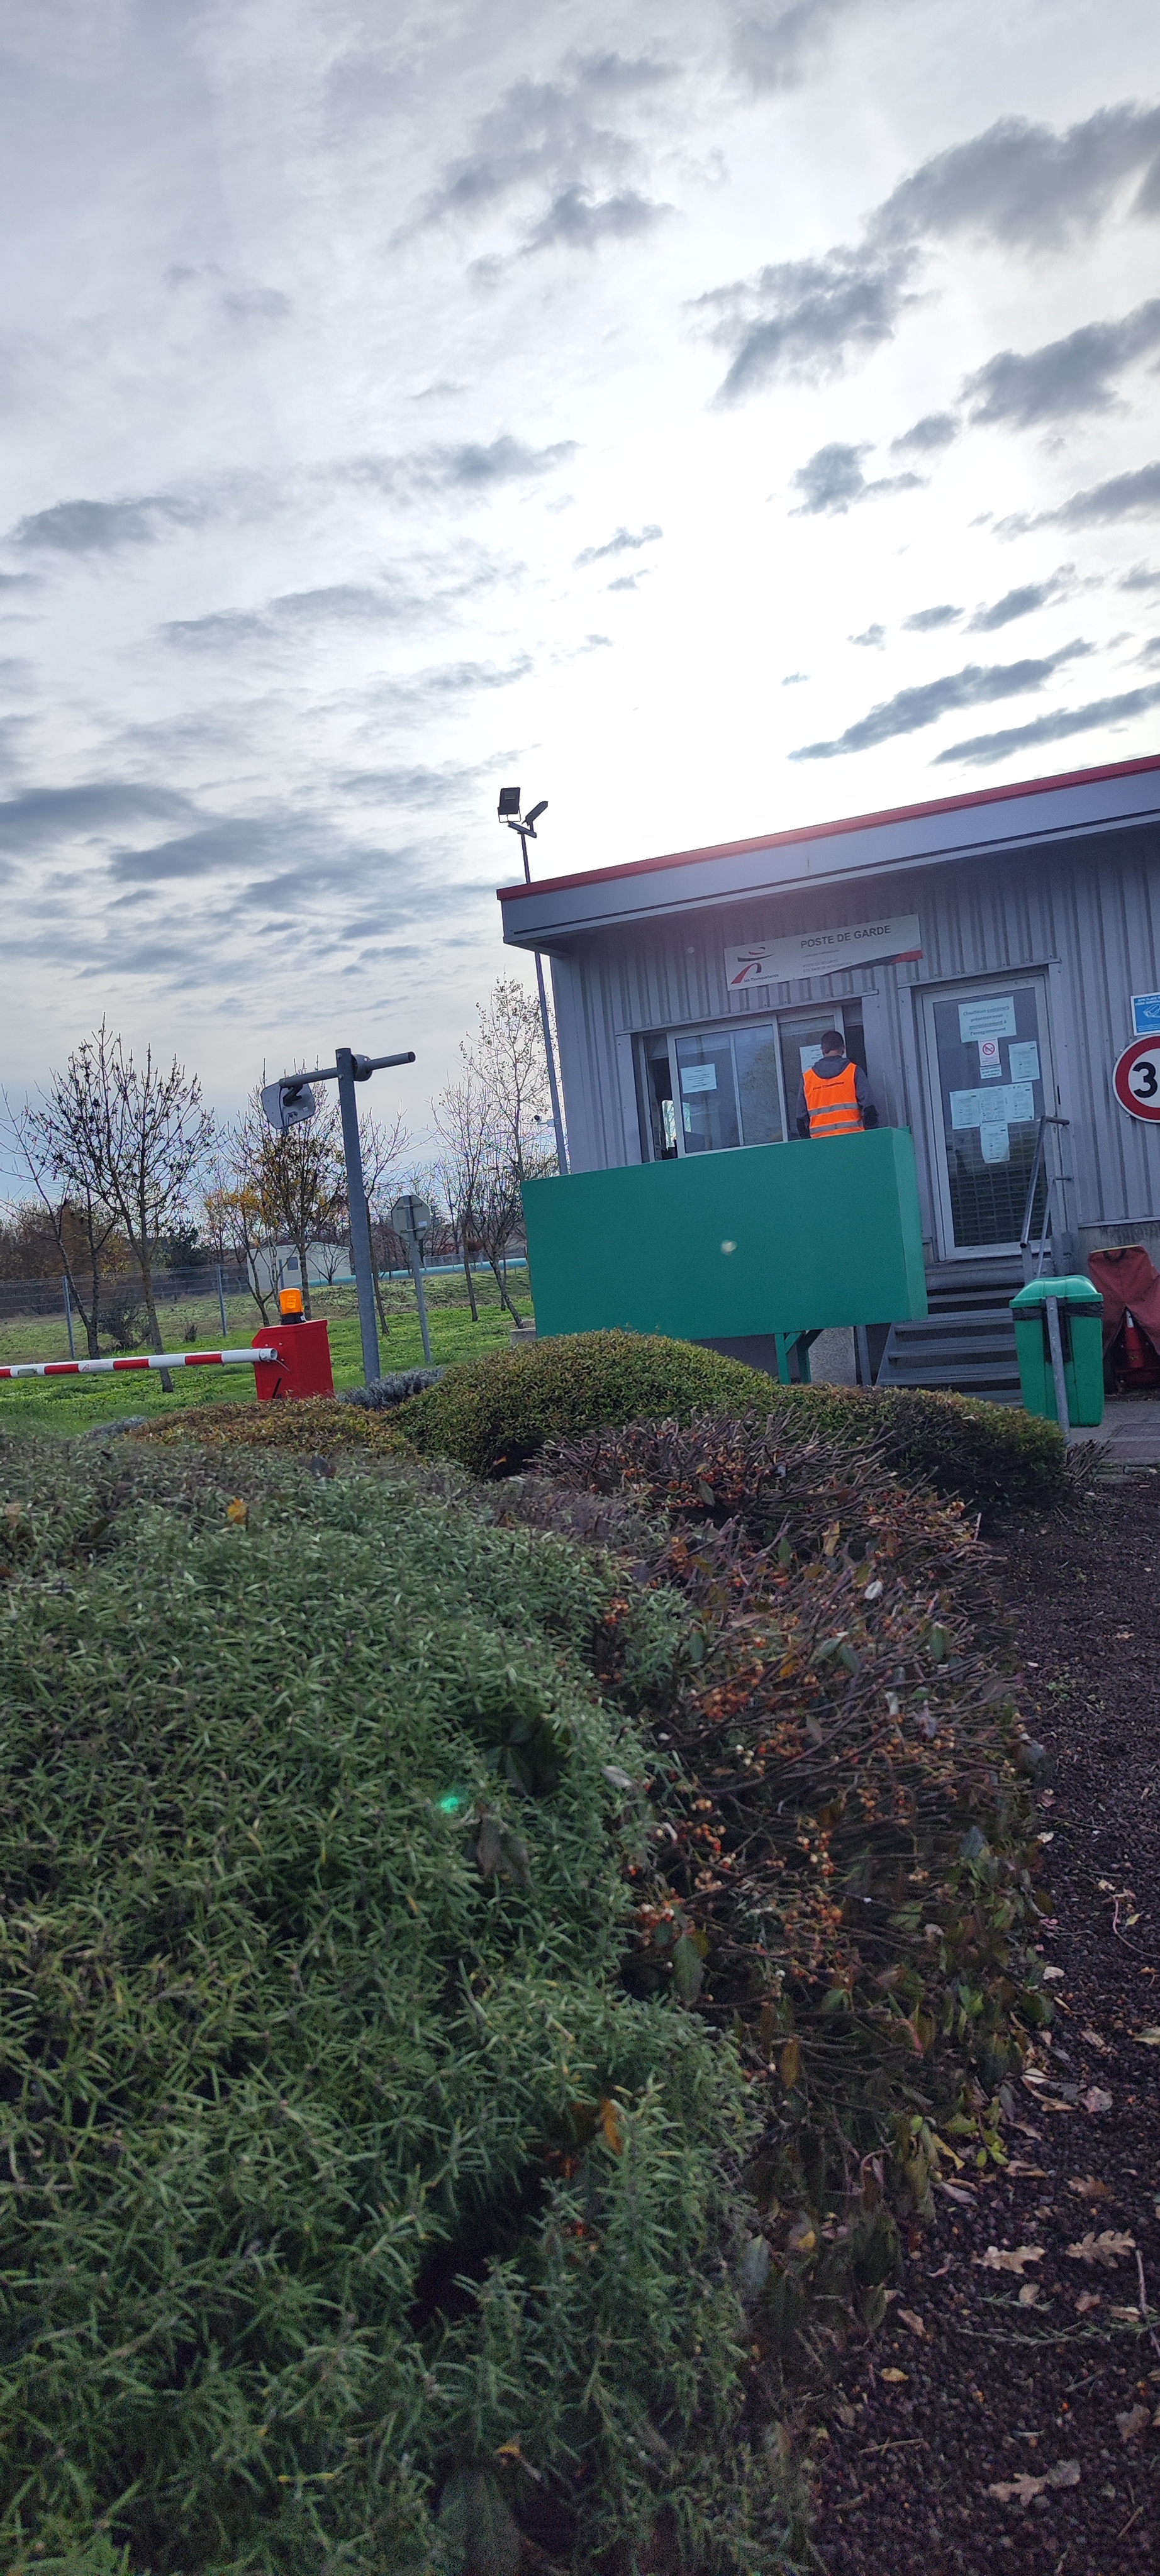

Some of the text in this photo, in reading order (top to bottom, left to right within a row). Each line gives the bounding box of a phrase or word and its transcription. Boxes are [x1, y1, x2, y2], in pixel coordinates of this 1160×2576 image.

[801, 925, 891, 948] POSTE DE GARDE
[1132, 1062, 1158, 1098] 3
